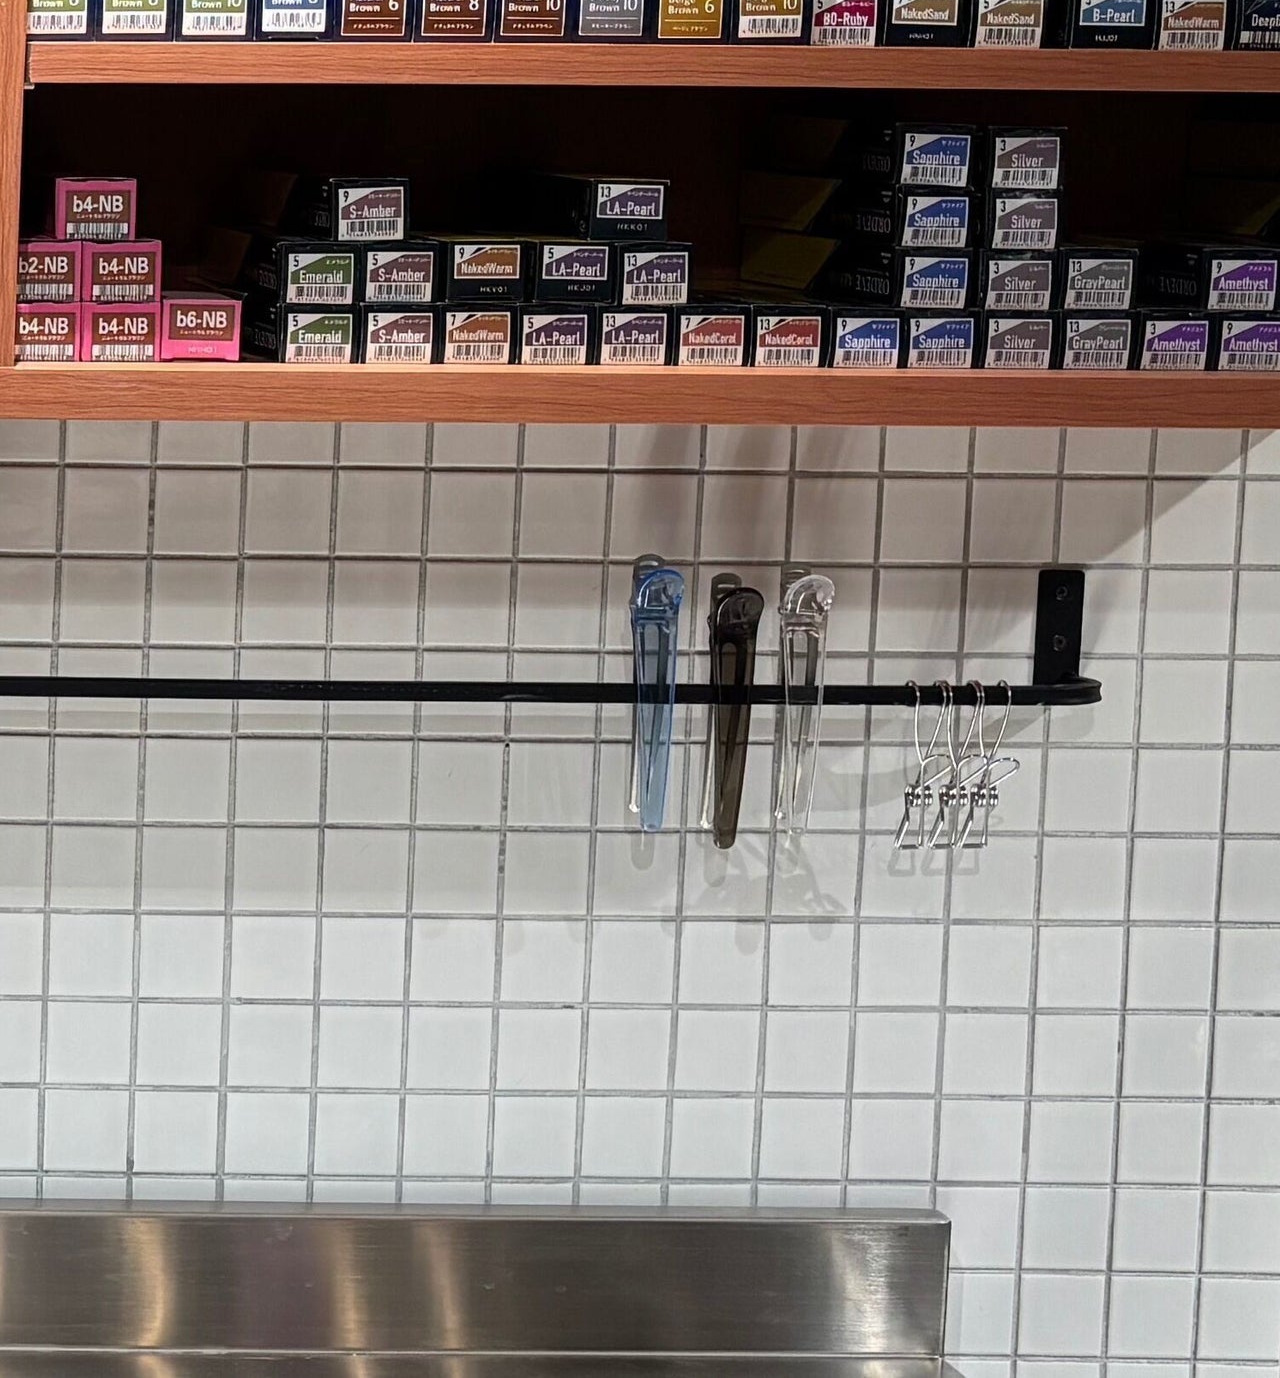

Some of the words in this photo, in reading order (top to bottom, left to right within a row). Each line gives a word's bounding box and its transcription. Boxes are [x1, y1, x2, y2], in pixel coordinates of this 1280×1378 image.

[430, 3, 461, 12] Brown
[745, 2, 776, 11] Brown
[1093, 9, 1135, 22] B-Pearl
[912, 151, 960, 165] Sapphire
[1011, 154, 1043, 168] Silver
[73, 195, 124, 212] b4-NB
[606, 201, 655, 216] LA-Pearl
[350, 205, 396, 219] S-Amber
[19, 256, 68, 273] b2-NB
[99, 257, 149, 274] b4-NB
[552, 262, 601, 277] LA-Pearl
[300, 270, 343, 283] Emerald
[1074, 276, 1125, 291] GrayPearl
[1218, 277, 1268, 291] Amethyst
[19, 317, 68, 334] b4-NB
[176, 311, 227, 328] b6-NB
[379, 330, 426, 343] S-Amber
[845, 335, 891, 348] Sapphire
[1151, 338, 1200, 352] Amethyst
